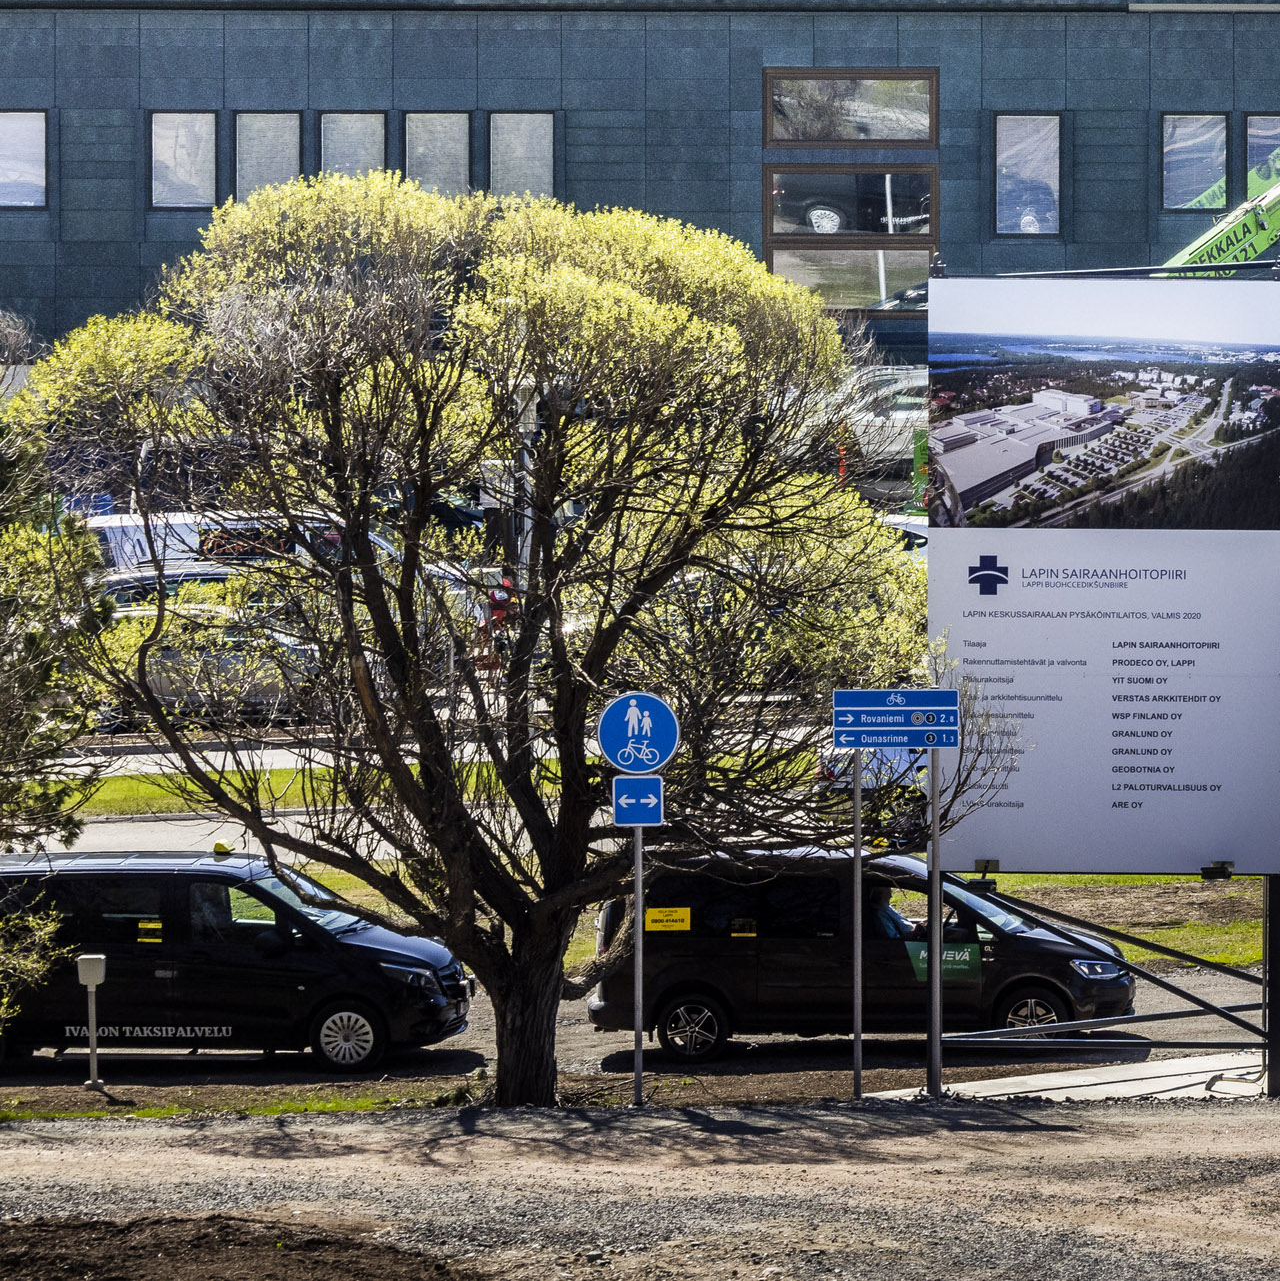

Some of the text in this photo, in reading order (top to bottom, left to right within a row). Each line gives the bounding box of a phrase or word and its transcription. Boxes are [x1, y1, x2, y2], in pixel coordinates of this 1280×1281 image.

[1021, 568, 1187, 580] LAPIN SAIRAANHOITOPIIRI
[962, 610, 987, 618] LAPIN
[988, 610, 1068, 619] KESKUSSAIRAALAN
[1069, 609, 1150, 620] PYSÄKÖINTILAITOS,
[1151, 611, 1182, 619] VALMIS
[963, 640, 987, 649] Tilaaja
[1112, 641, 1137, 649] LAPIN
[963, 657, 1047, 666] Rakennuttamistehtävät
[1048, 659, 1055, 667] ja
[1112, 659, 1154, 667] PRODECO
[1156, 659, 1169, 668] OY,
[1127, 677, 1154, 685] SUOMI
[1156, 677, 1168, 685] OY
[990, 693, 1063, 702] arkkitehtisuunnittelu
[1152, 695, 1207, 703] ARKKITEHDIT
[861, 714, 905, 723] Rovaniemi
[861, 734, 908, 743] Ounasrinne
[1112, 730, 1159, 738] GRANLUND
[1160, 748, 1173, 756] OY
[123, 1026, 232, 1037] TAKSIPALVELU
